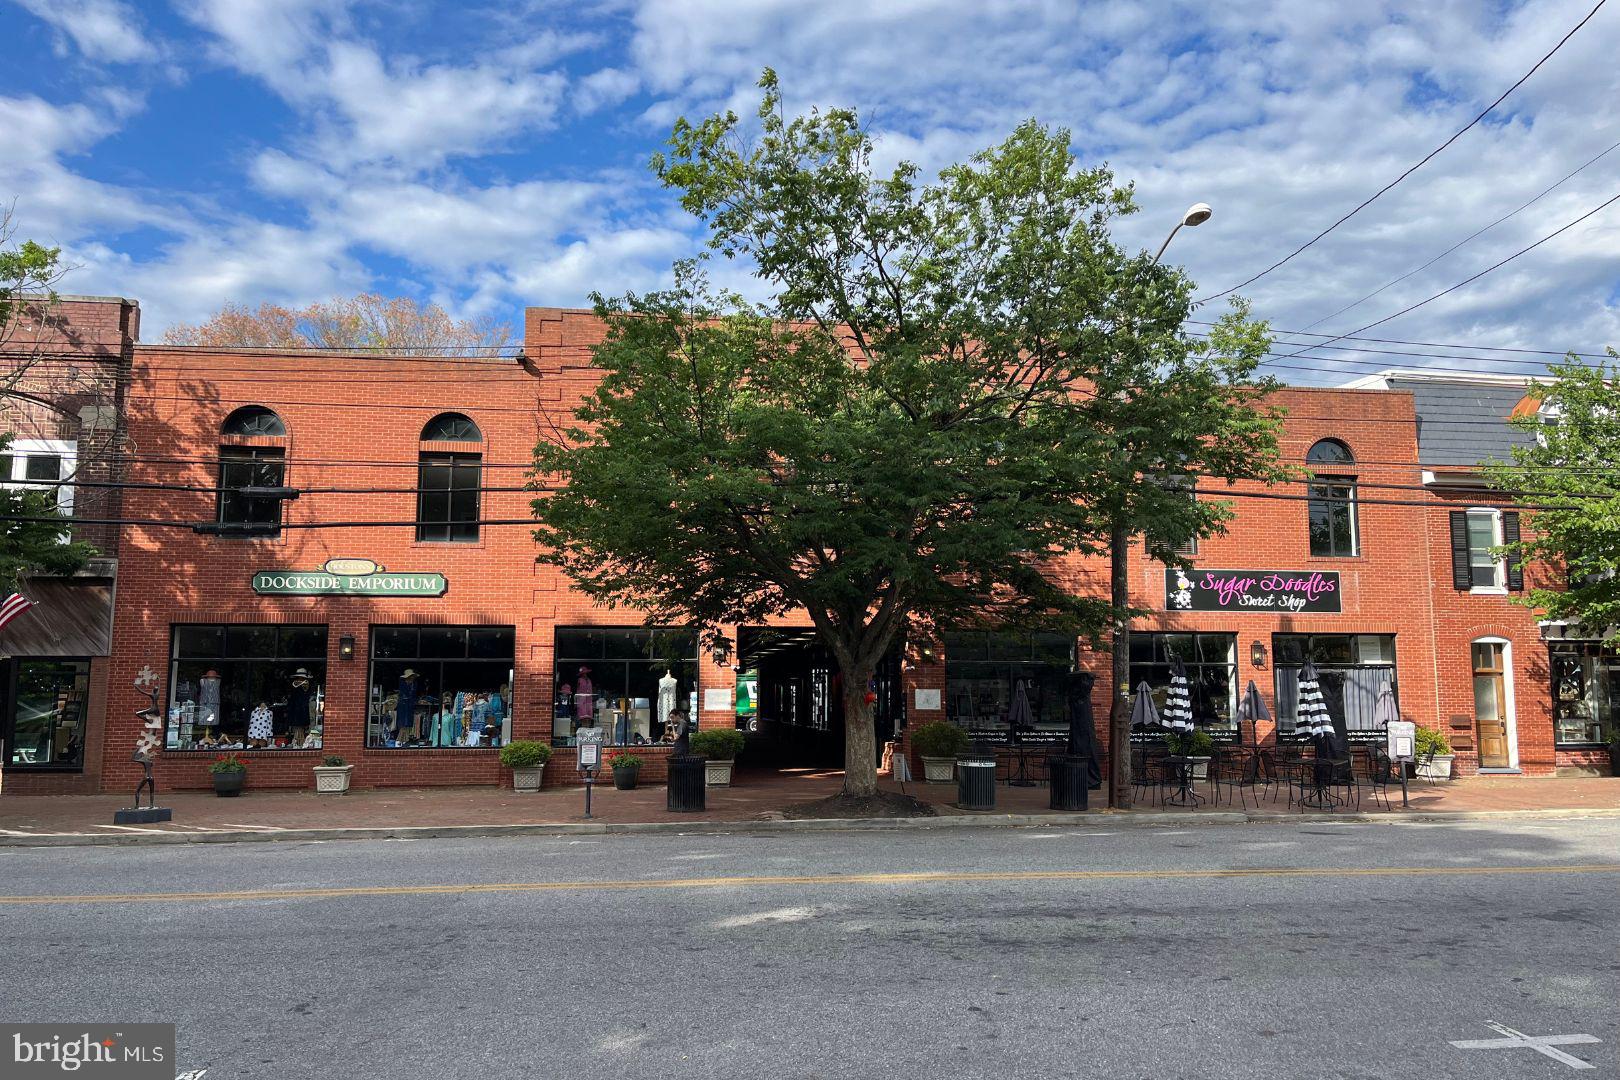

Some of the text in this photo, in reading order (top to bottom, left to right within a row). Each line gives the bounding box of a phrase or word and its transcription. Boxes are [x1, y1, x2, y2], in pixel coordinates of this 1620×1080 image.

[260, 576, 437, 590] DOCKSIDE EMPORIUM
[1200, 572, 1336, 606] Sugar Doodles
[1238, 593, 1308, 612] Sweet Shop
